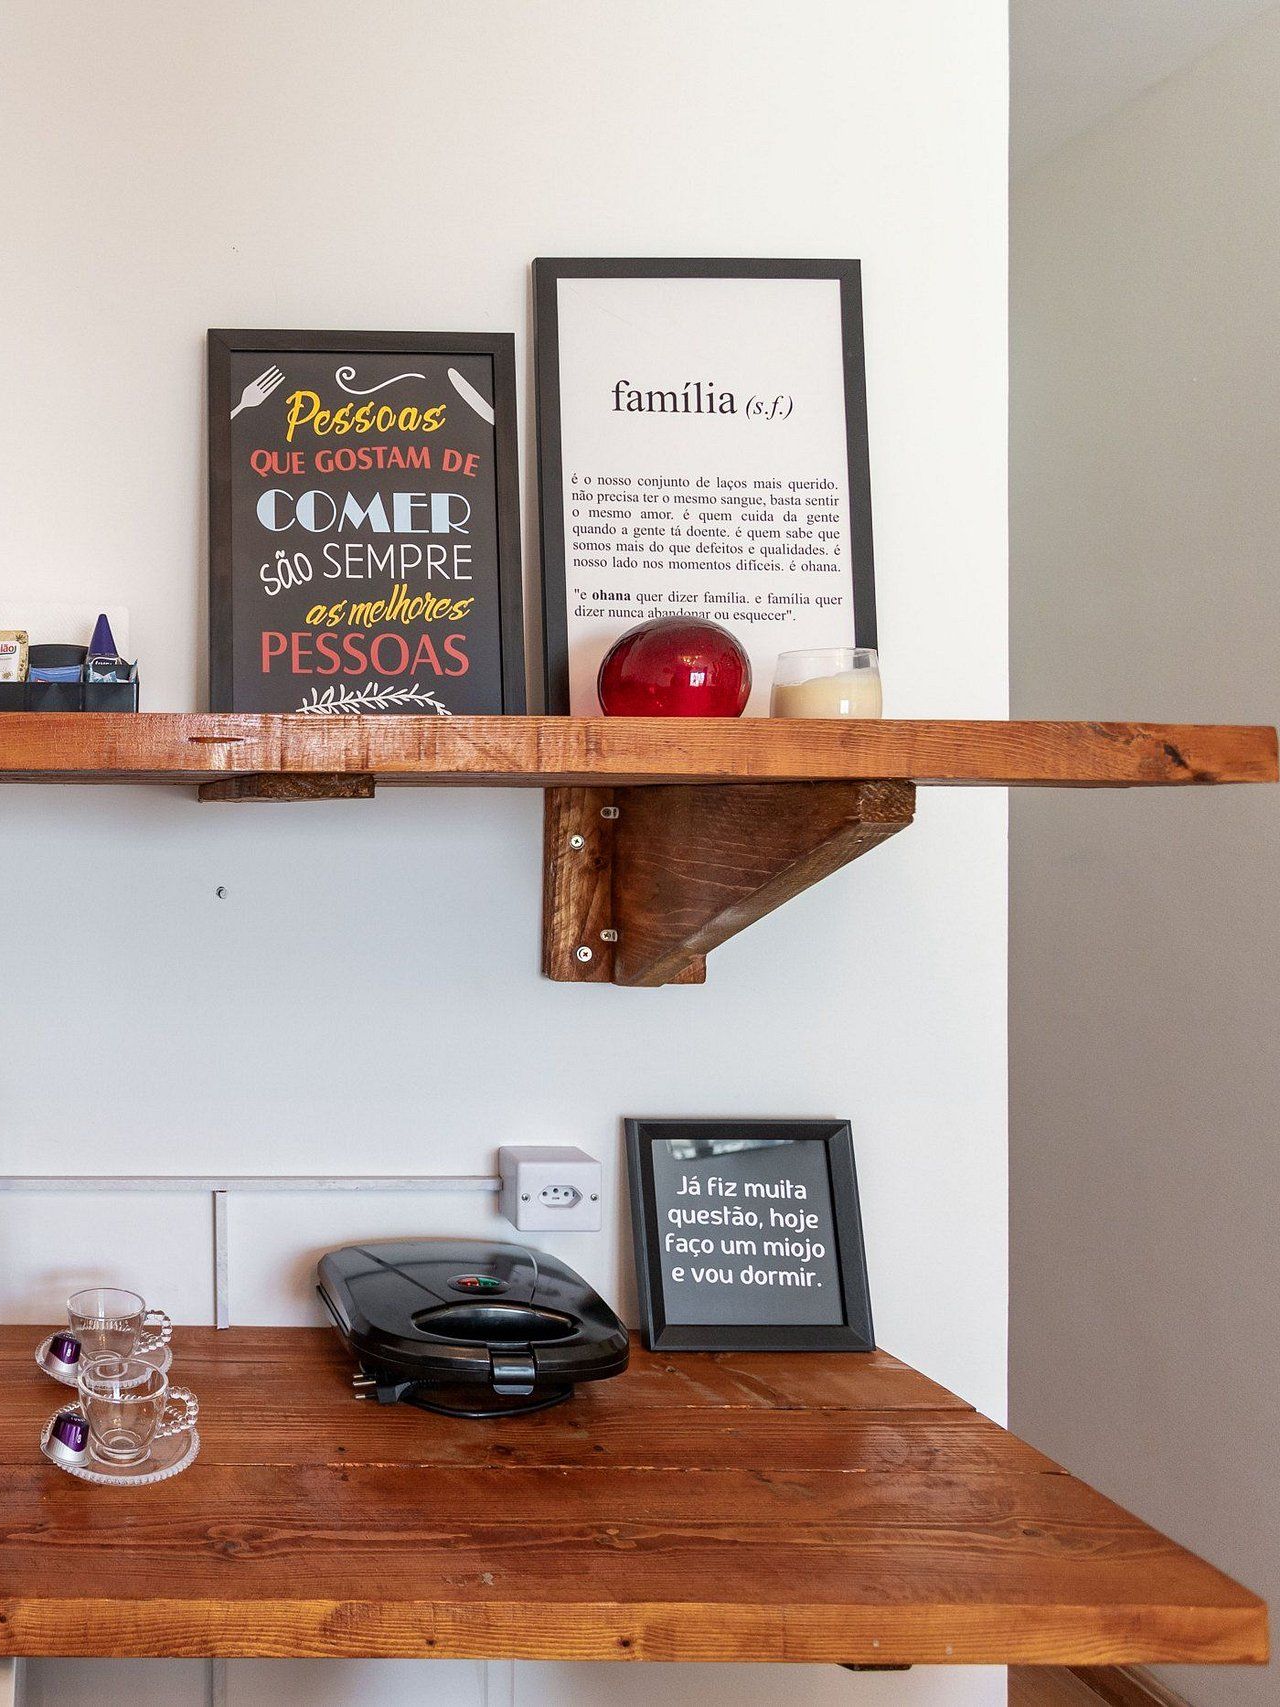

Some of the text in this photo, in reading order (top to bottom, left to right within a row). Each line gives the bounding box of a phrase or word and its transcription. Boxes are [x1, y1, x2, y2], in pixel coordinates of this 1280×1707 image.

[611, 379, 793, 421] família (s.f.)
[286, 391, 447, 443] Pessoas
[250, 446, 480, 477] QUE GOSTAM DE
[571, 472, 838, 493] é o nosso conjunto de laços mais querido.
[256, 488, 471, 534] COMER
[571, 489, 840, 508] não precisa ter o mesmo sangue, basta sentir
[571, 508, 840, 526] o mesmo amor. é quem cuida da gente
[572, 522, 840, 542] quando a gente tá doente. é quem sabe que
[572, 540, 841, 558] somos mais do que defeitos e qualidades. é
[259, 543, 472, 596] são SEMPRE
[573, 556, 841, 572] nosso lado nos momentos difíceis. é ohana.
[305, 583, 475, 628] as melhores
[574, 588, 843, 608] "e ohana quer dizer família. e família quer
[574, 605, 605, 618] dizer
[608, 607, 644, 618] nunca
[714, 610, 729, 620] ou
[733, 609, 796, 624] esquecer".
[261, 632, 470, 677] PESSOAS
[676, 1175, 807, 1200] Já fiz muita
[667, 1206, 819, 1233] questão, hoje
[665, 1233, 826, 1263] faço um miojo
[671, 1265, 822, 1288] e vou dormir.
